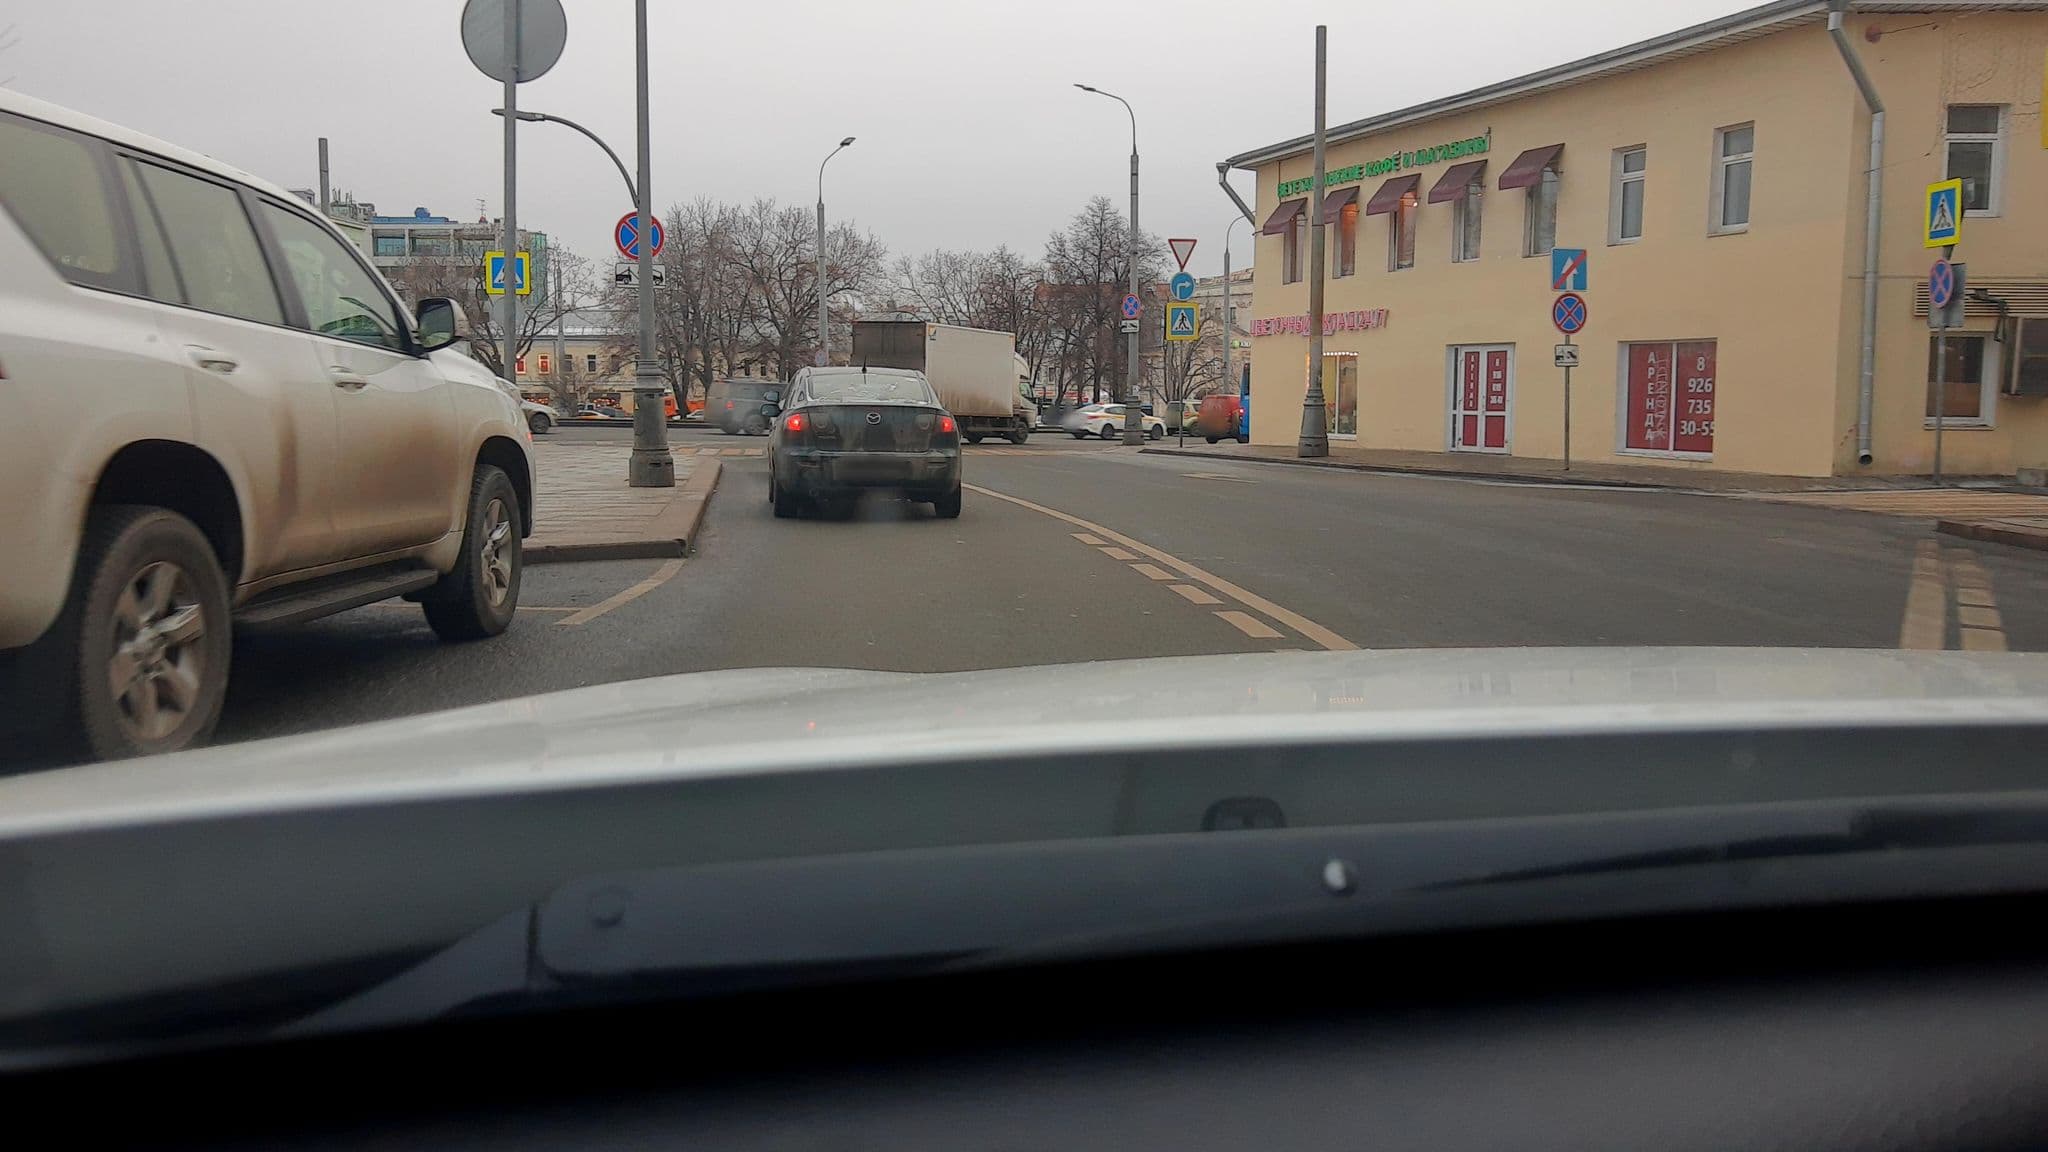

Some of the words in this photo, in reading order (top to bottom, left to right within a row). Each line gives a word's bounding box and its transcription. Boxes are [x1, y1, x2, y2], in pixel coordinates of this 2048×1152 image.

[1322, 311, 1357, 334] КЛАД
[1696, 356, 1706, 372] 8
[1688, 377, 1713, 393] 926
[1644, 351, 1656, 441] АРЕНДА
[1687, 399, 1712, 415] 735
